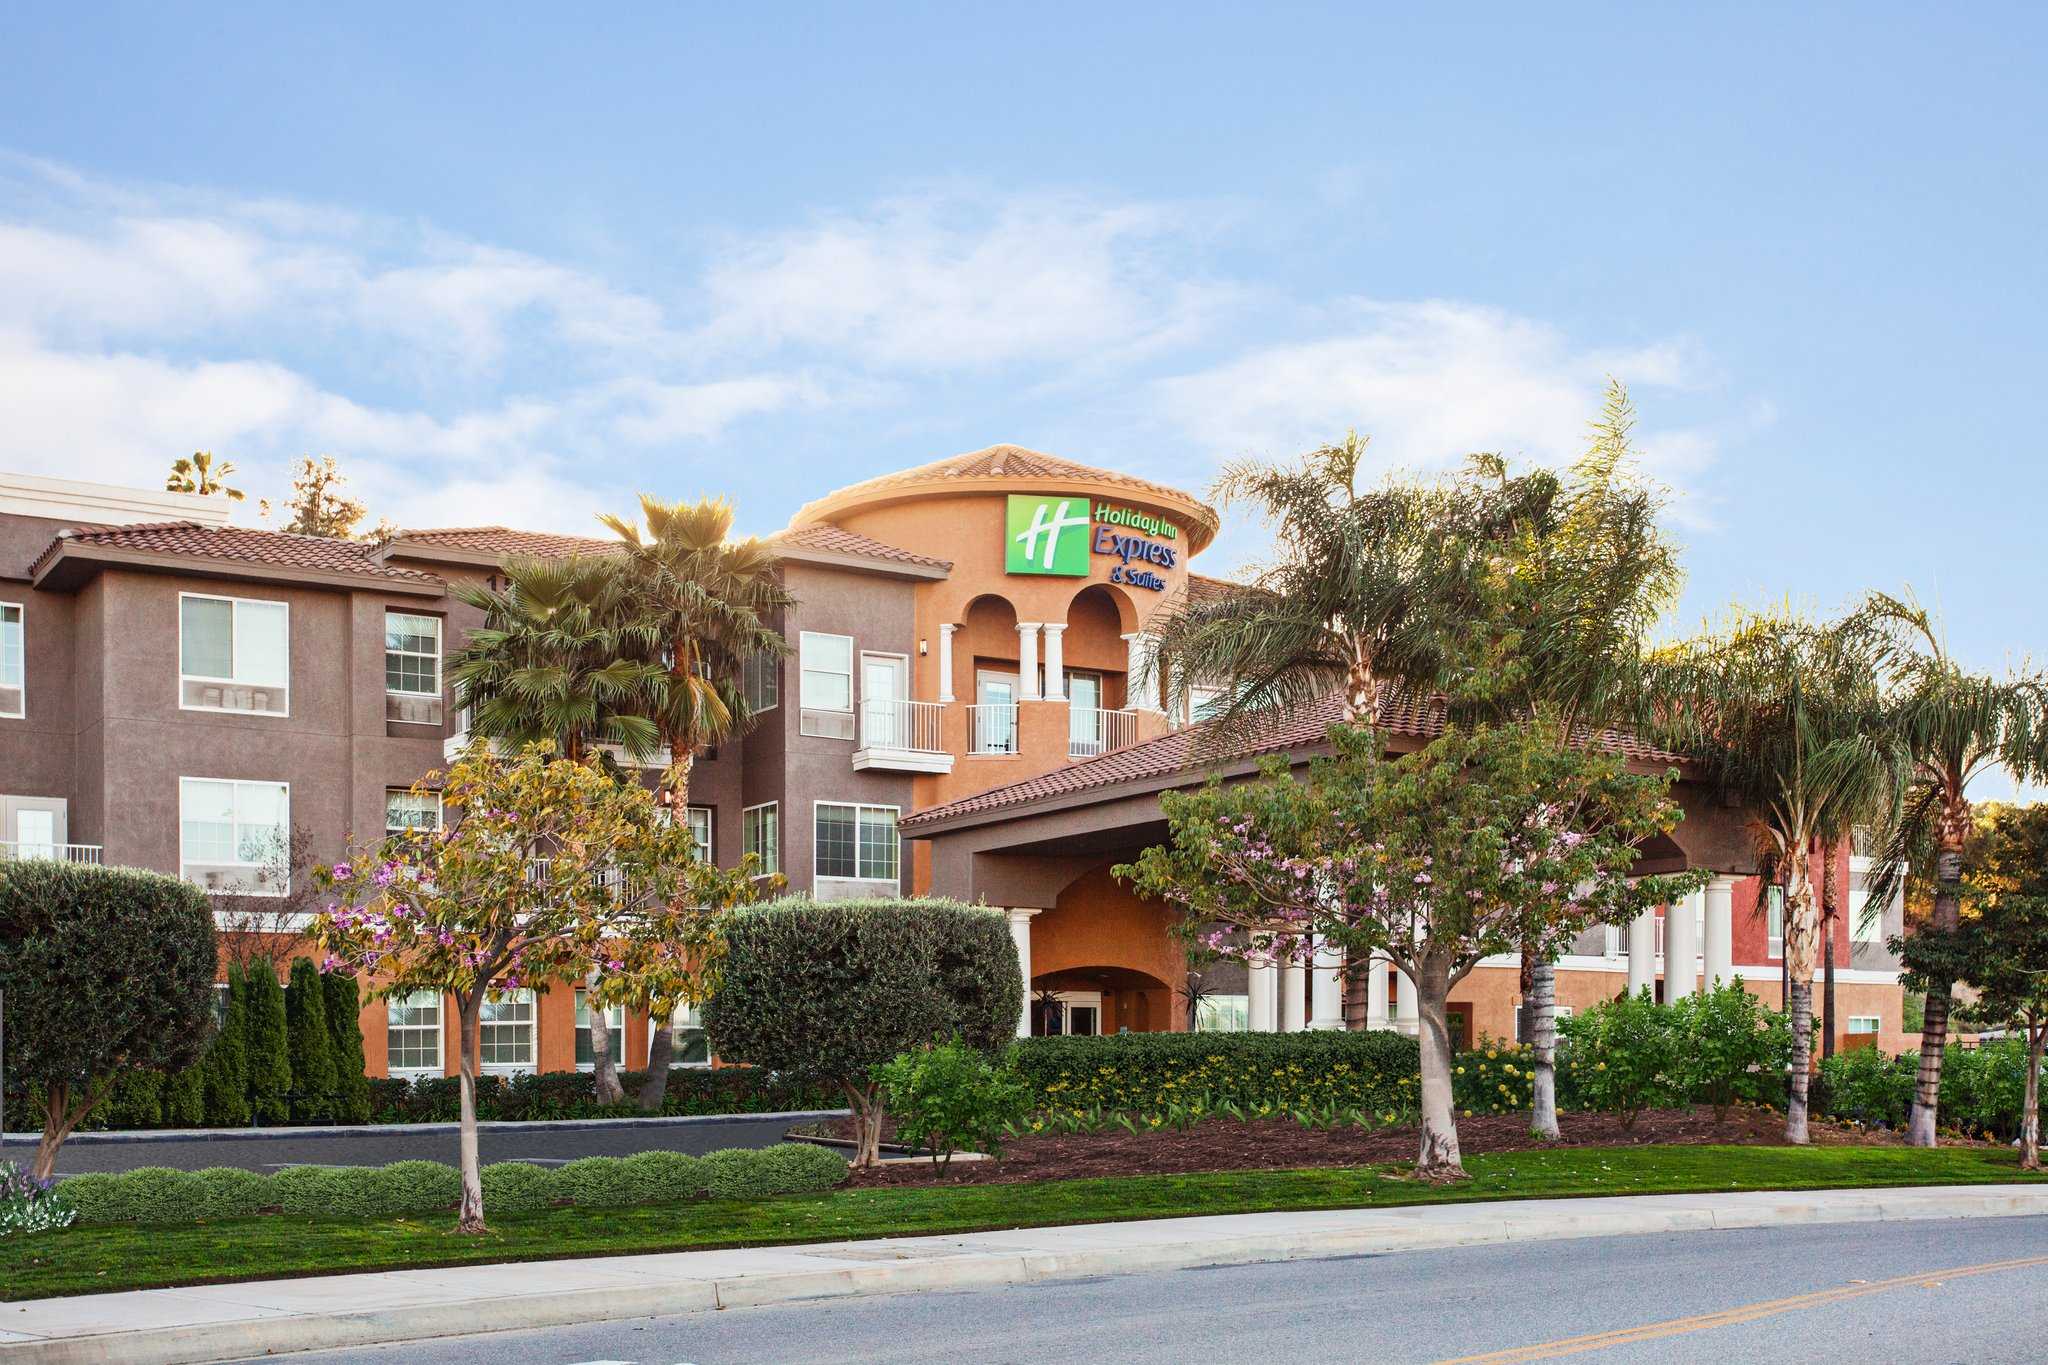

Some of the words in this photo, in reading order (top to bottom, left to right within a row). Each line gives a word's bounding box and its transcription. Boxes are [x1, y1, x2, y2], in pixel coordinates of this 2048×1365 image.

[1095, 502, 1160, 536] Holiday
[1161, 515, 1178, 540] Inn
[1094, 524, 1177, 568] Express
[1111, 566, 1126, 584] &
[1126, 567, 1166, 592] Suites
